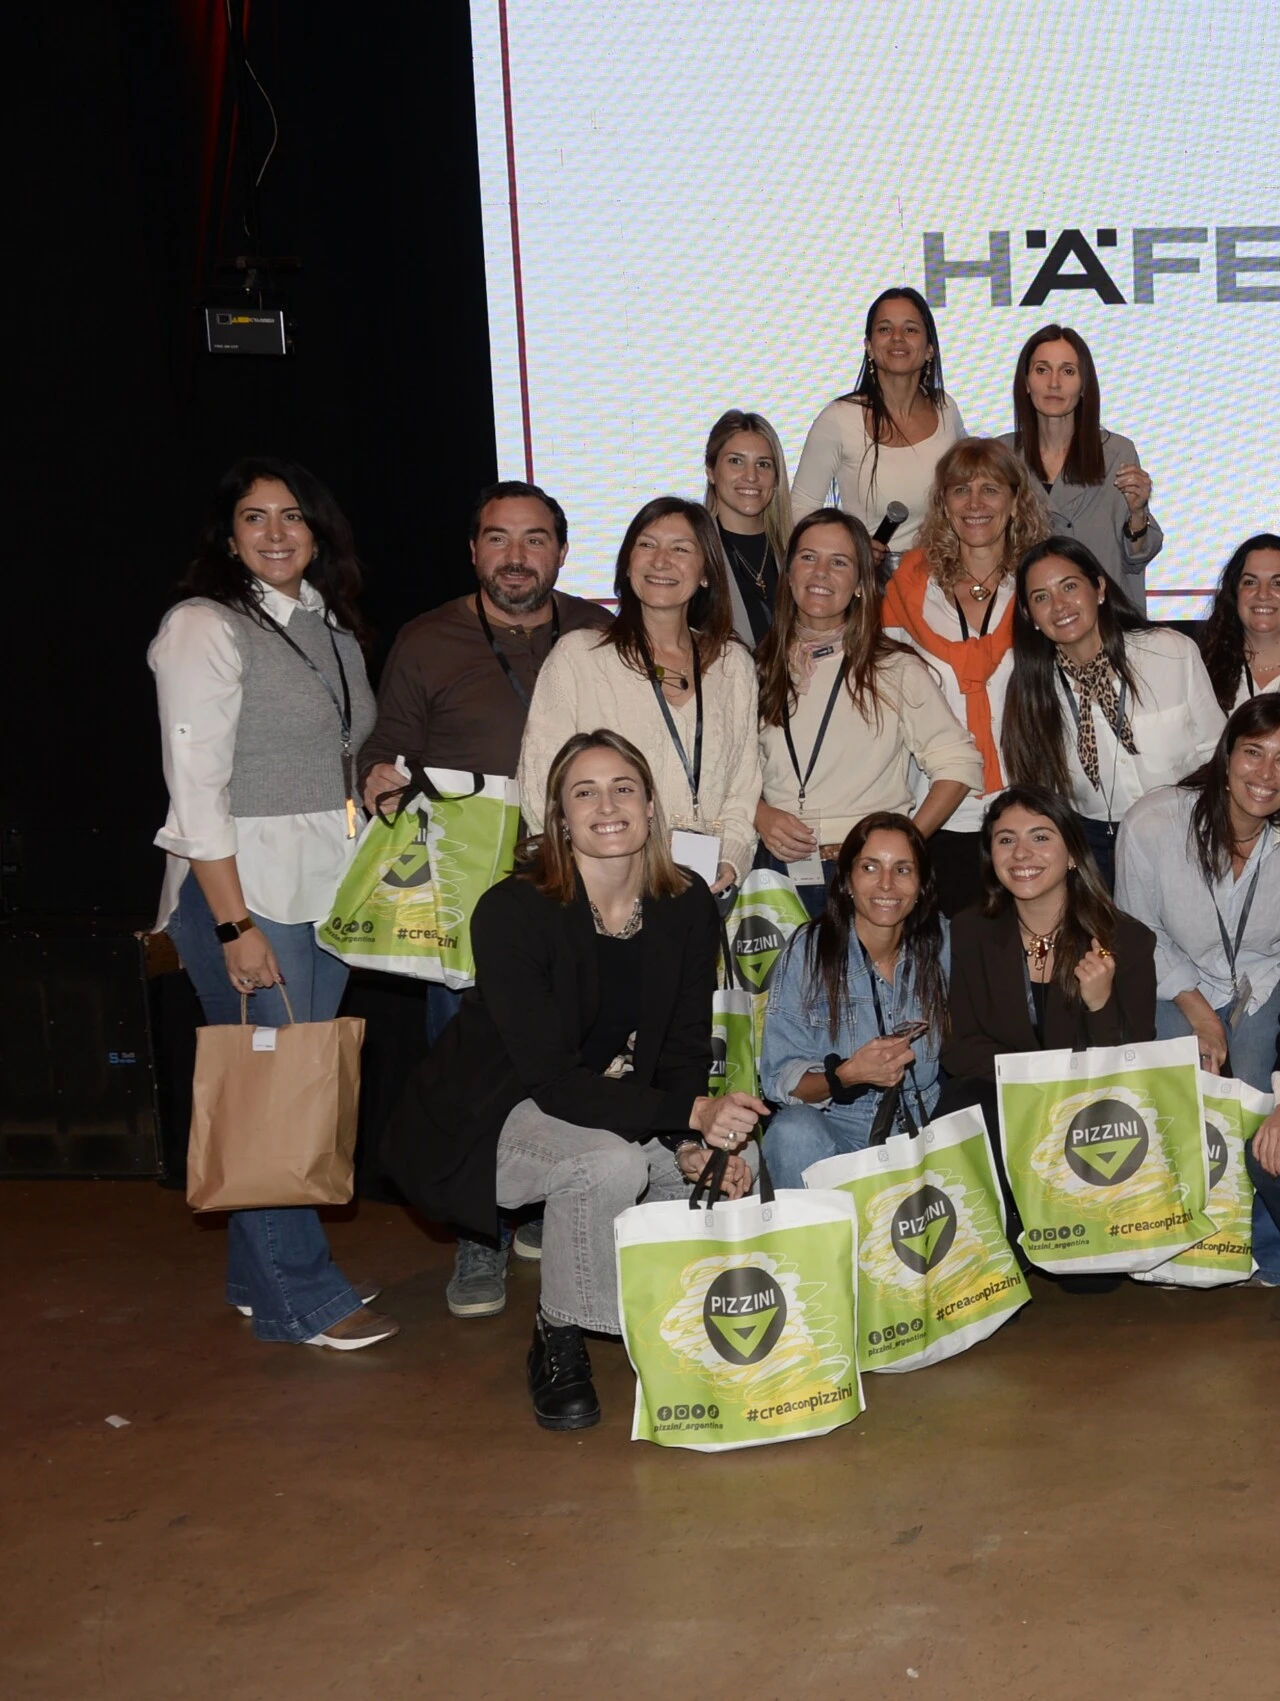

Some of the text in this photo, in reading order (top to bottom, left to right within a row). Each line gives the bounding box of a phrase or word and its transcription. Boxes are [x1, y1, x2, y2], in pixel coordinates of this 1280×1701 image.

[1072, 1120, 1139, 1144] PIZZINI
[711, 1288, 776, 1314] PIZZINI
[936, 1272, 1022, 1322] #creaconpizzini
[747, 1383, 853, 1422] #creaconpizzini
[654, 1421, 723, 1433] pizzini_argentina
